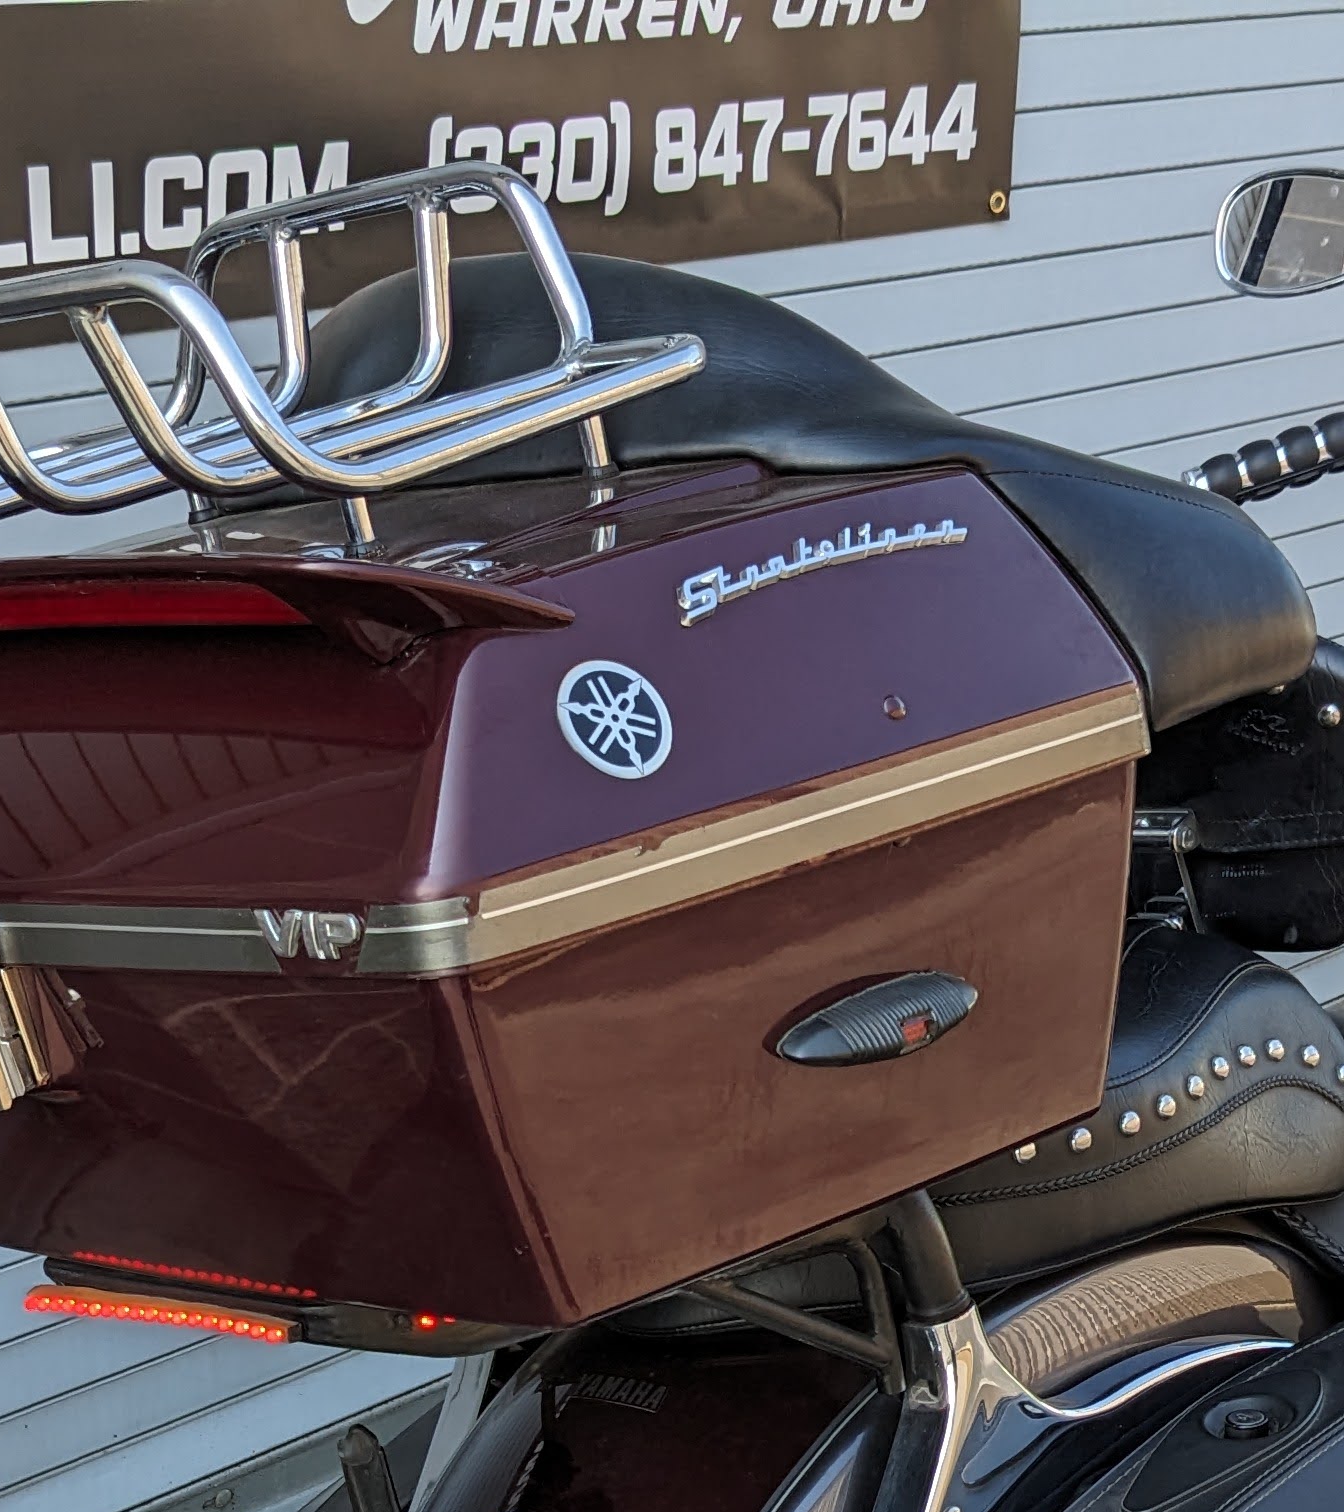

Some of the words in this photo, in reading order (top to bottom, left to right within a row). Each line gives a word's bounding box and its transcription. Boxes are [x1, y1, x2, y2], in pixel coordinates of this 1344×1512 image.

[413, 0, 743, 53] WARREN,
[653, 82, 978, 194] 847-7644
[676, 519, 968, 627] Stratoliner
[254, 908, 364, 960] VIP
[578, 1373, 667, 1409] YAMAHA
